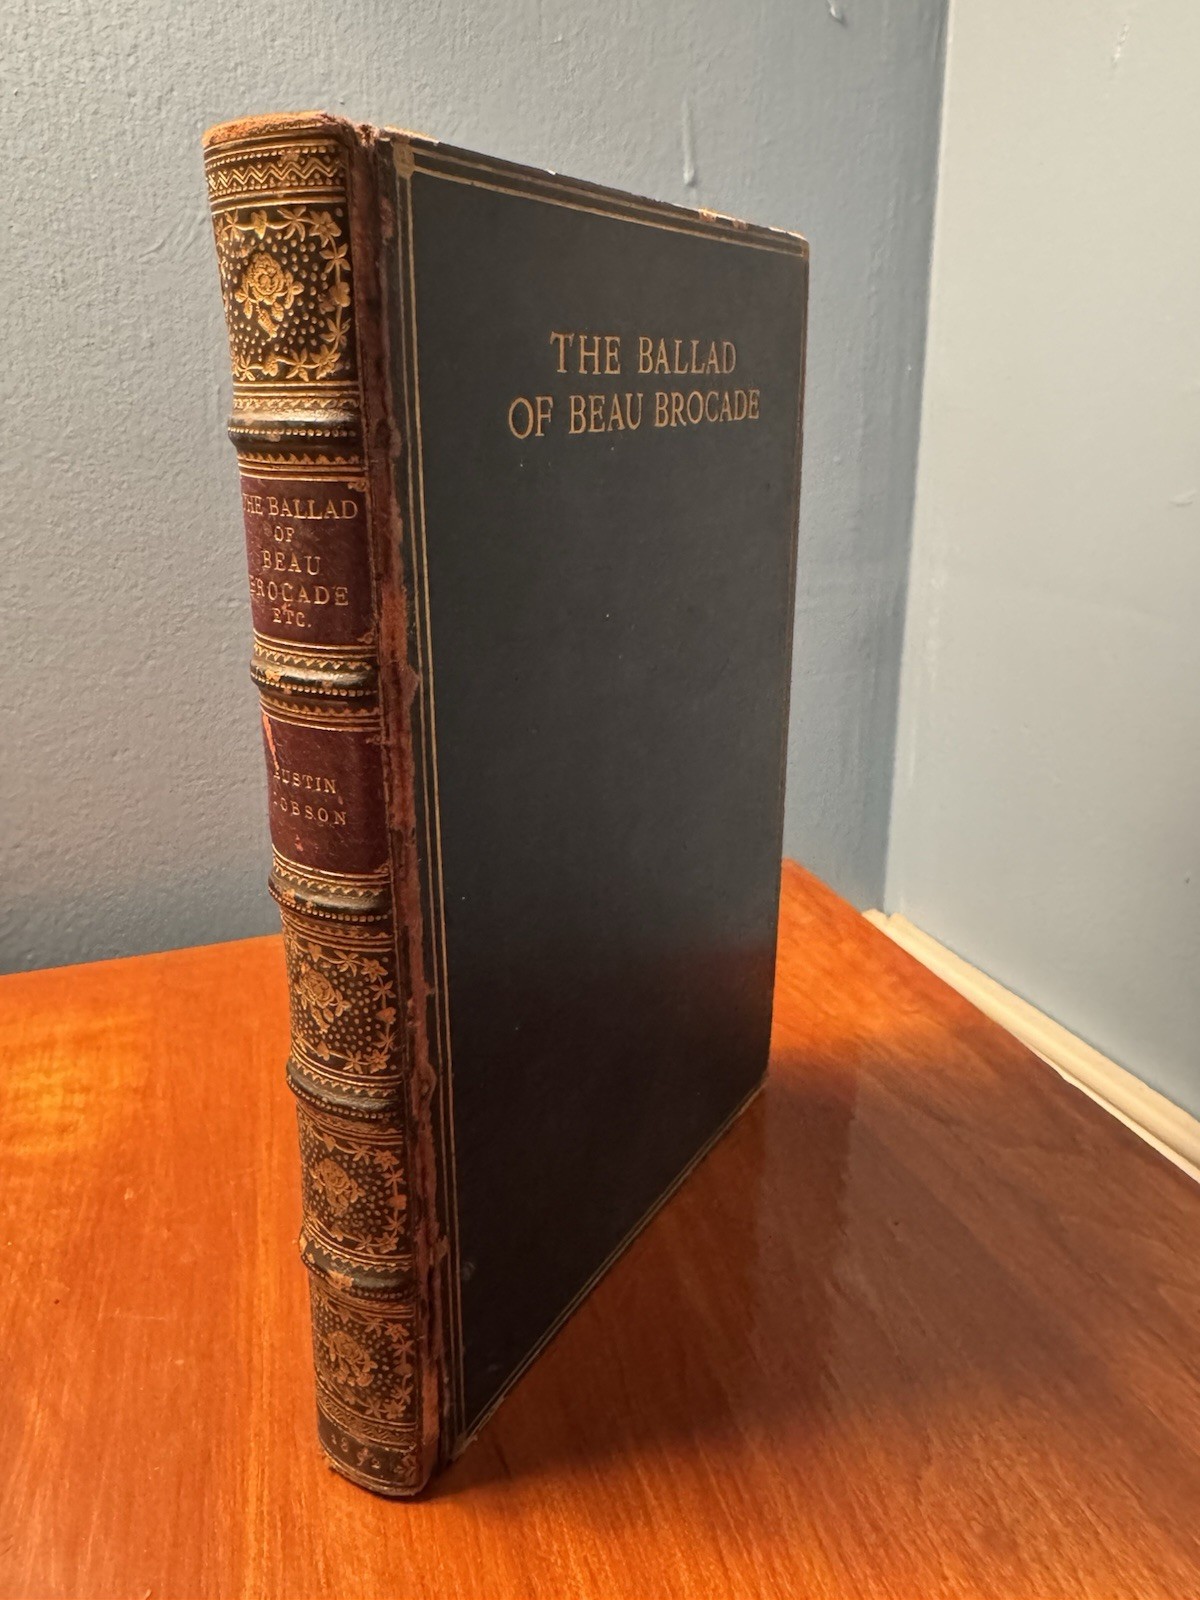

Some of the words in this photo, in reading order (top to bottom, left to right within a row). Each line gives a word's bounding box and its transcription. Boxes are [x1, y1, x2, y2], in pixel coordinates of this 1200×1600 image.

[550, 331, 621, 374] THE
[638, 336, 736, 374] BALLAD
[508, 396, 553, 439] OF
[568, 393, 643, 434] BEAU
[654, 389, 760, 427] BROCADE
[267, 496, 358, 519] BALLAD
[274, 526, 295, 542] OF
[261, 550, 320, 575] BEAU
[272, 607, 312, 627] ETC.
[274, 792, 346, 825] OBSON
